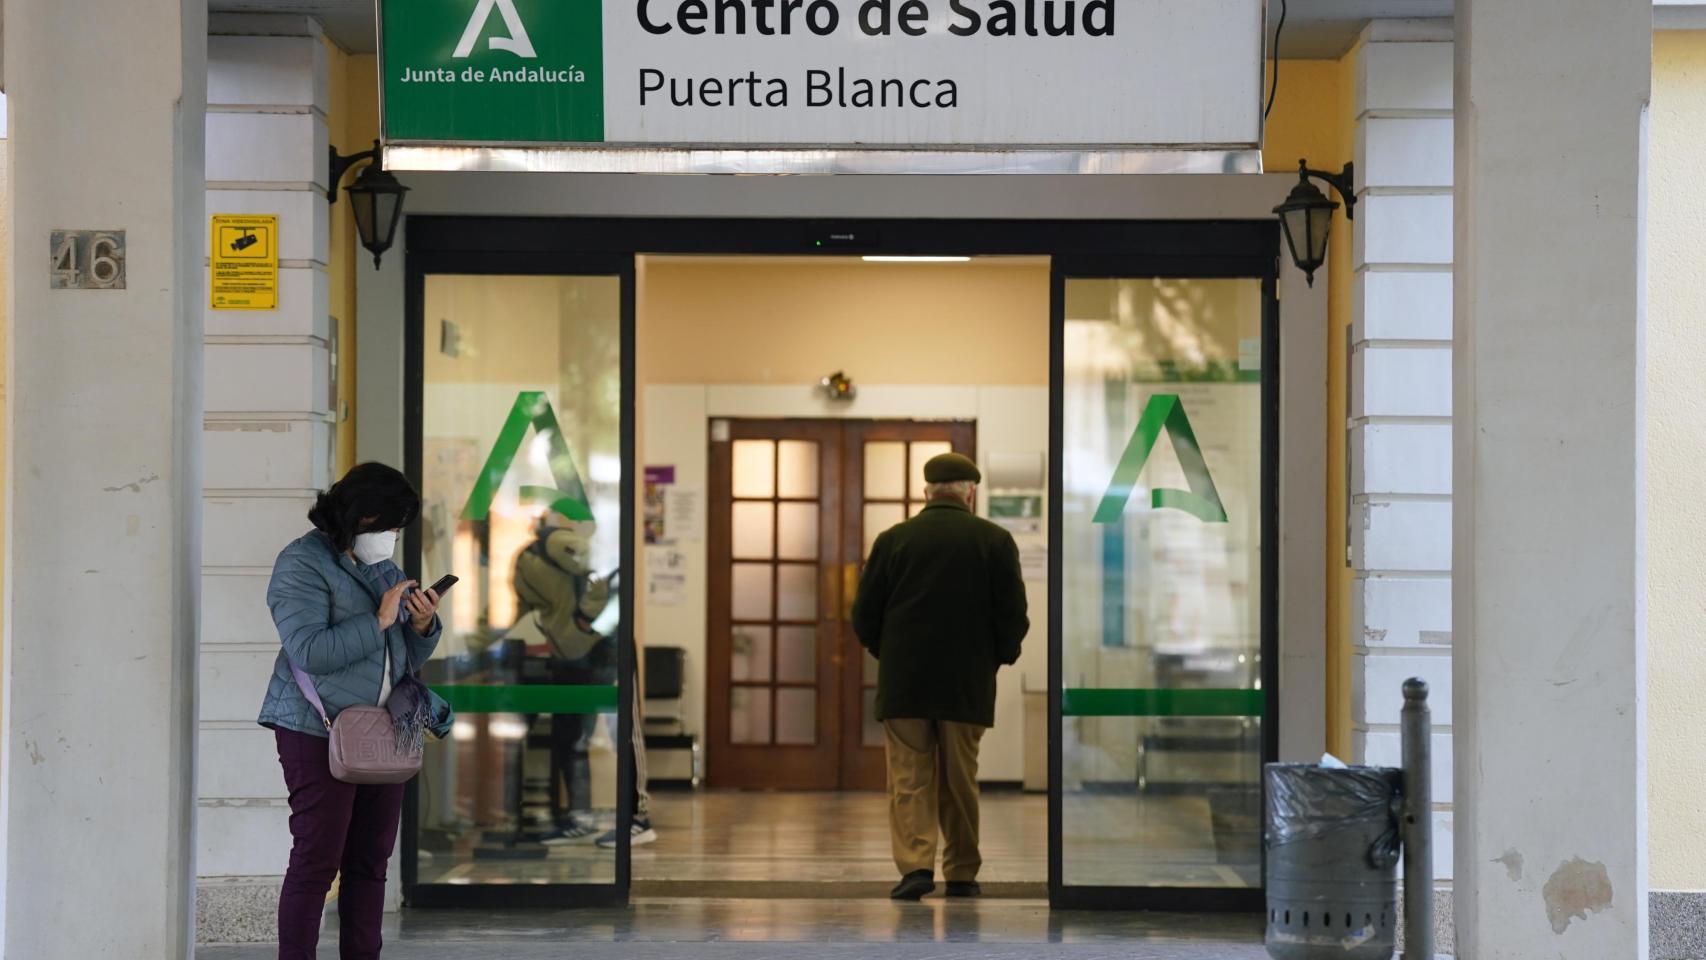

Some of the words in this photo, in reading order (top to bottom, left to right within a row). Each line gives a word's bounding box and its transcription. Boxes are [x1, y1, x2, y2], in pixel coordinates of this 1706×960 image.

[636, 0, 840, 37] Centro
[858, 0, 929, 37] de
[947, 0, 1116, 37] Salud
[400, 67, 456, 83] Junta
[461, 66, 485, 83] de
[489, 65, 585, 83] Andalucía
[639, 68, 788, 108] Puerta
[806, 66, 958, 109] Blanca
[52, 235, 119, 284] 46
